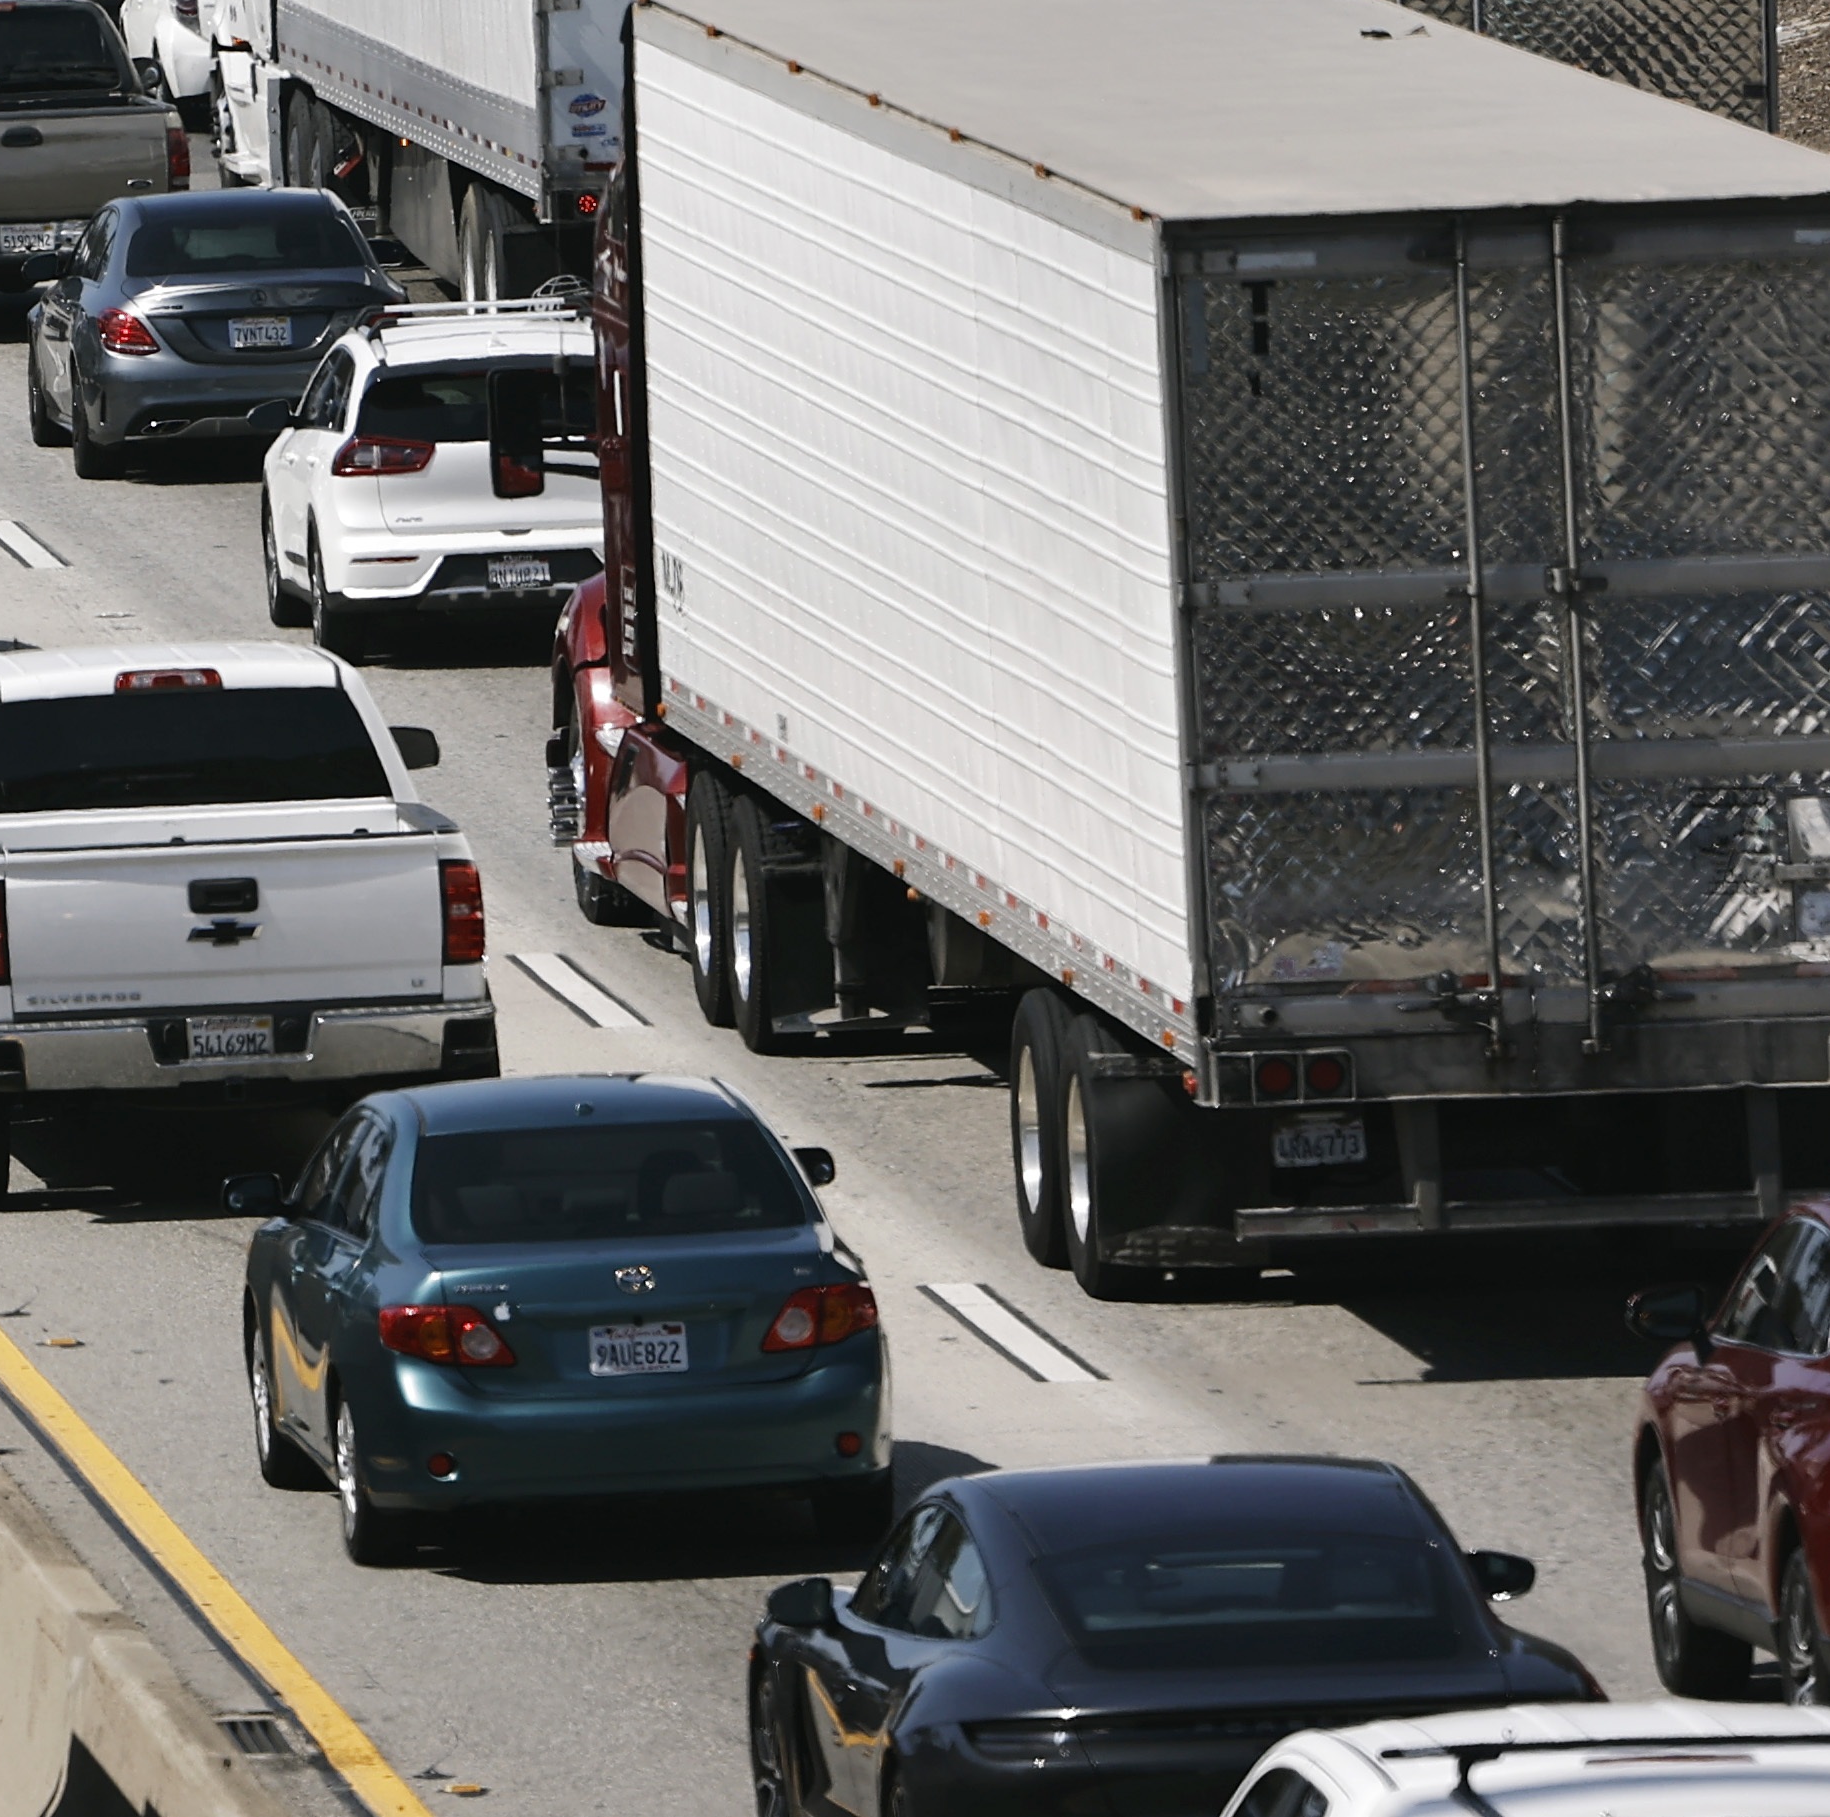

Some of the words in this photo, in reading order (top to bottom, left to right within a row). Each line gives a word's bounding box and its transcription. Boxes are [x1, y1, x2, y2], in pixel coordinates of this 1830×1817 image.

[234, 326, 288, 343] 7VNT432
[27, 991, 142, 1005] SILVERADO
[193, 1032, 269, 1057] 54169M2
[596, 1340, 682, 1367] 9AUE822
